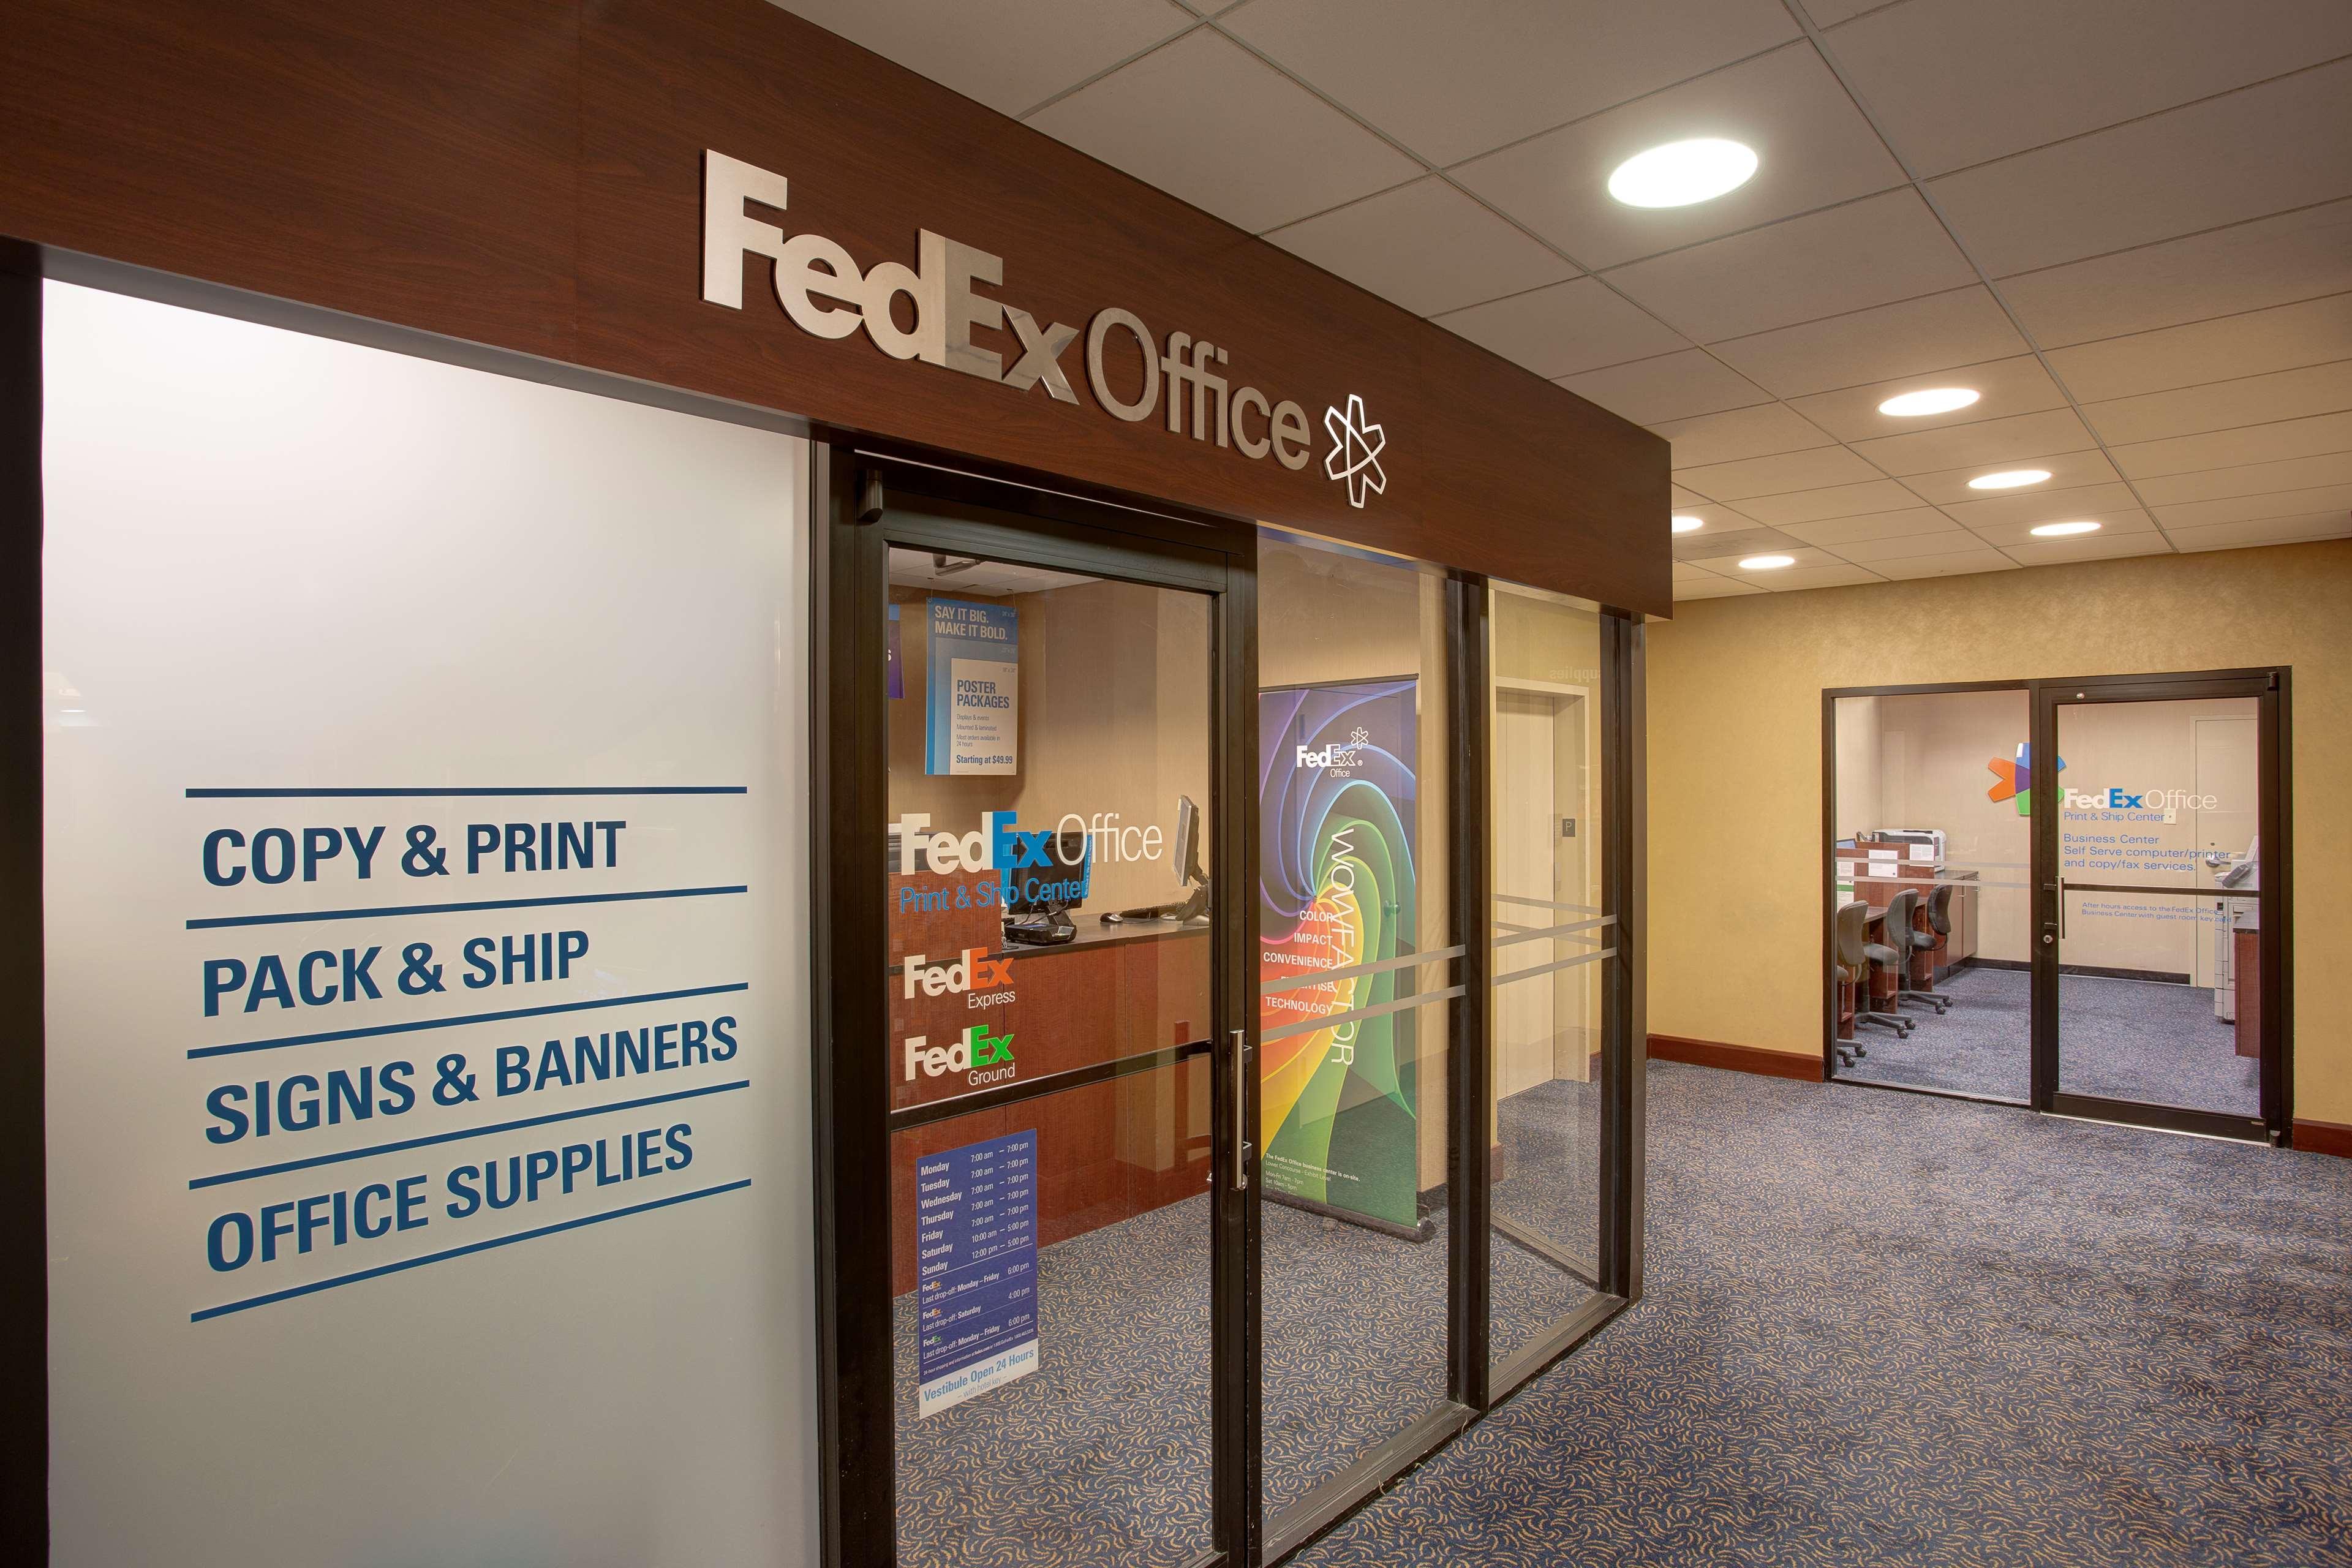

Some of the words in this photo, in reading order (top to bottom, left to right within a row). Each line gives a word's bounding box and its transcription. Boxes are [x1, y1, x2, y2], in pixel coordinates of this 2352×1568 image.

[700, 148, 1079, 405] FedEx
[1086, 307, 1311, 470] Office
[935, 605, 955, 619] SAY
[958, 608, 967, 620] IT
[970, 609, 989, 624] BIG.
[935, 620, 965, 636] MAKE
[969, 624, 978, 636] IT
[981, 626, 1008, 640] BOLD.
[957, 680, 995, 694] POSTER
[957, 694, 1009, 708] PACKAGES
[957, 755, 982, 765] Starting
[1330, 769, 1350, 778] Office
[2064, 788, 2143, 809] FedEx
[2145, 790, 2218, 809] Office
[2064, 812, 2087, 821] Print
[2090, 813, 2098, 821] &
[2101, 812, 2124, 823] Ship
[2127, 813, 2164, 821] Center
[901, 812, 1053, 875] FedEx
[1057, 813, 1163, 865] Office
[2064, 834, 2116, 843] Business
[2120, 834, 2159, 844] Center
[203, 826, 386, 887] COPY
[401, 825, 450, 877] &
[467, 821, 627, 875] PRINT
[2064, 846, 2086, 854] Self
[2090, 846, 2122, 856] Serve
[2127, 848, 2231, 860] computer/printer
[2064, 859, 2084, 867] and
[2089, 859, 2139, 870] copy/fax
[2144, 861, 2196, 871] services.
[901, 886, 949, 913] Print
[956, 885, 970, 909] &
[1300, 910, 1333, 922] COLOR
[1294, 932, 1333, 946] IMPACT
[1264, 952, 1333, 969] CONVENIENCE
[203, 946, 383, 1017] PACK
[398, 943, 447, 995] &
[462, 930, 589, 989] SHIP
[905, 948, 1014, 999] FedEx
[968, 989, 1016, 1009] Express
[1265, 997, 1333, 1014] TECHNOLOGY
[905, 1025, 1015, 1081] FedEx
[206, 1061, 416, 1145] SIGNS
[432, 1053, 480, 1106] &
[497, 1016, 738, 1097] BANNERS
[968, 1063, 1015, 1087] Ground
[921, 1162, 949, 1176] Monday
[971, 1152, 982, 1163] 7:00
[1007, 1143, 1018, 1153] 7:00
[1020, 1142, 1028, 1150] pm
[1279, 1164, 1300, 1174] Concourse
[1303, 1162, 1322, 1171] business
[921, 1178, 949, 1193] Tuesday
[971, 1169, 982, 1178] 7:00
[1007, 1159, 1018, 1169] 7:00
[1020, 1158, 1028, 1166] pm
[206, 1174, 429, 1273] OFFICE
[446, 1123, 693, 1219] SUPPLIES
[921, 1192, 962, 1209] Wednesday
[971, 1185, 982, 1195] 7:00
[1008, 1175, 1018, 1185] 7:00
[922, 1210, 954, 1225] Thursday
[971, 1200, 983, 1211] 7:00
[1008, 1190, 1018, 1200] 7:00
[1020, 1189, 1028, 1197] pm
[922, 1230, 943, 1243] Friday
[971, 1216, 983, 1227] 7:00
[1008, 1205, 1019, 1216] 7:00
[1020, 1204, 1028, 1213] pm
[922, 1243, 953, 1259] Saturday
[972, 1232, 986, 1243] 10:00
[1008, 1222, 1019, 1232] 5:00
[922, 1262, 948, 1275] Sunday
[972, 1248, 987, 1259] 12:00
[989, 1245, 997, 1255] pm
[1008, 1237, 1019, 1247] 5:00
[1020, 1235, 1028, 1244] pm
[922, 1295, 934, 1304] Last
[935, 1286, 957, 1300] drop-off:
[957, 1280, 979, 1292] Monday
[984, 1272, 1000, 1283] Friday
[1008, 1264, 1019, 1275] 6:00
[1020, 1262, 1030, 1271] pm
[922, 1280, 941, 1292] FedEx
[923, 1323, 935, 1332] Last
[935, 1313, 957, 1327] drop-off:
[958, 1305, 981, 1319] Saturday
[1008, 1289, 1020, 1299] 4:00
[1020, 1287, 1030, 1297] pm
[923, 1308, 941, 1319] FedEx
[923, 1350, 935, 1360] Last
[935, 1340, 957, 1355] drop-off:
[958, 1333, 979, 1346] Monday
[984, 1325, 1000, 1335] Friday
[1008, 1316, 1020, 1327] 6:00
[1020, 1313, 1030, 1323] pm
[923, 1335, 941, 1347] FedEx
[924, 1376, 967, 1401] Vestibule
[971, 1366, 993, 1382] Open
[997, 1359, 1006, 1372] 24
[1009, 1349, 1034, 1366] Hours
[963, 1386, 976, 1397] with
